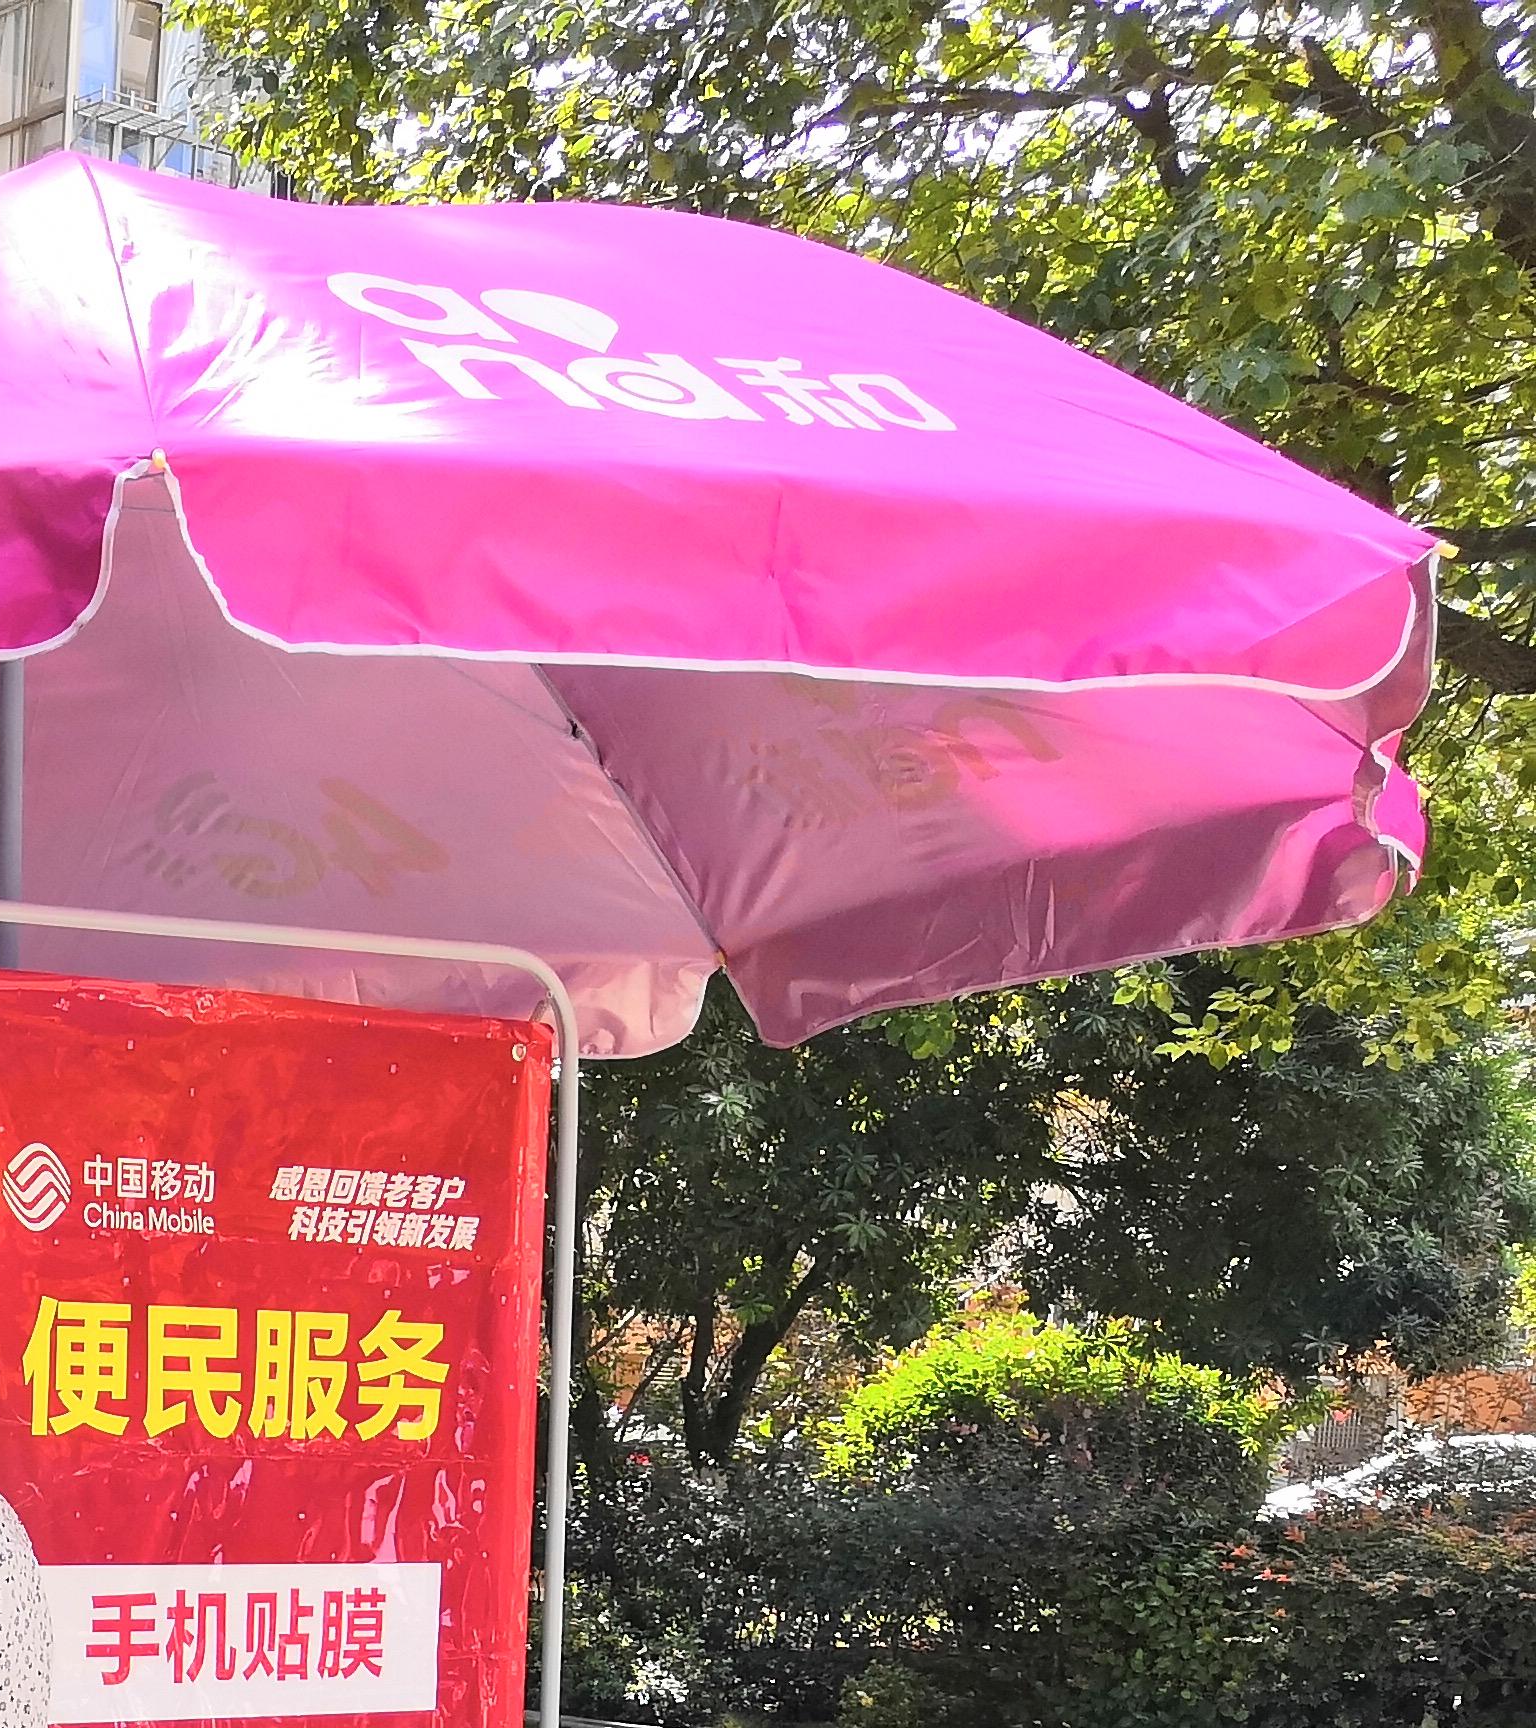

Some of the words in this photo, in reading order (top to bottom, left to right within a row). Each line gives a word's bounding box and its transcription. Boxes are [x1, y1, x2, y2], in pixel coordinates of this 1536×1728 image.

[83, 1153, 216, 1203] 中国移动
[269, 1165, 466, 1211] 感恩回馈老客户
[83, 1201, 145, 1231] China
[147, 1206, 215, 1235] Mobile
[288, 1206, 480, 1251] 科技引领新发展
[23, 1295, 450, 1442] 便民服务
[85, 1587, 387, 1686] 手机贴膜
